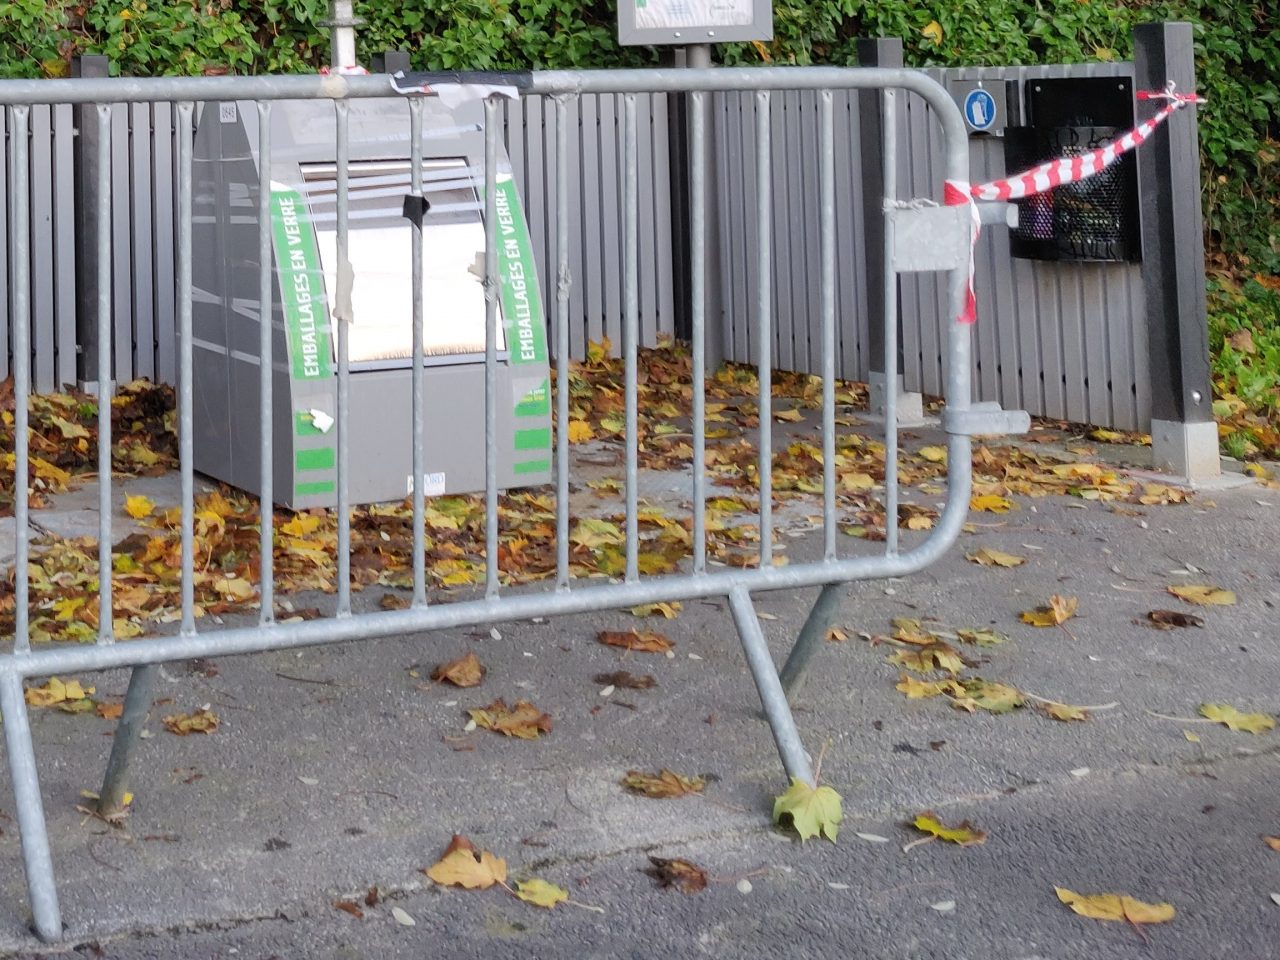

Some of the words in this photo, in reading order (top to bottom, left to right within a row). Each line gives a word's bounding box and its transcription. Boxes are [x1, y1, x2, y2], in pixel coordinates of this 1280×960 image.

[278, 196, 302, 246] VERRE
[289, 249, 307, 271] EN
[504, 239, 521, 259] EN
[293, 271, 320, 378] EMBALLAGES
[508, 261, 535, 361] EMBALLAGES
